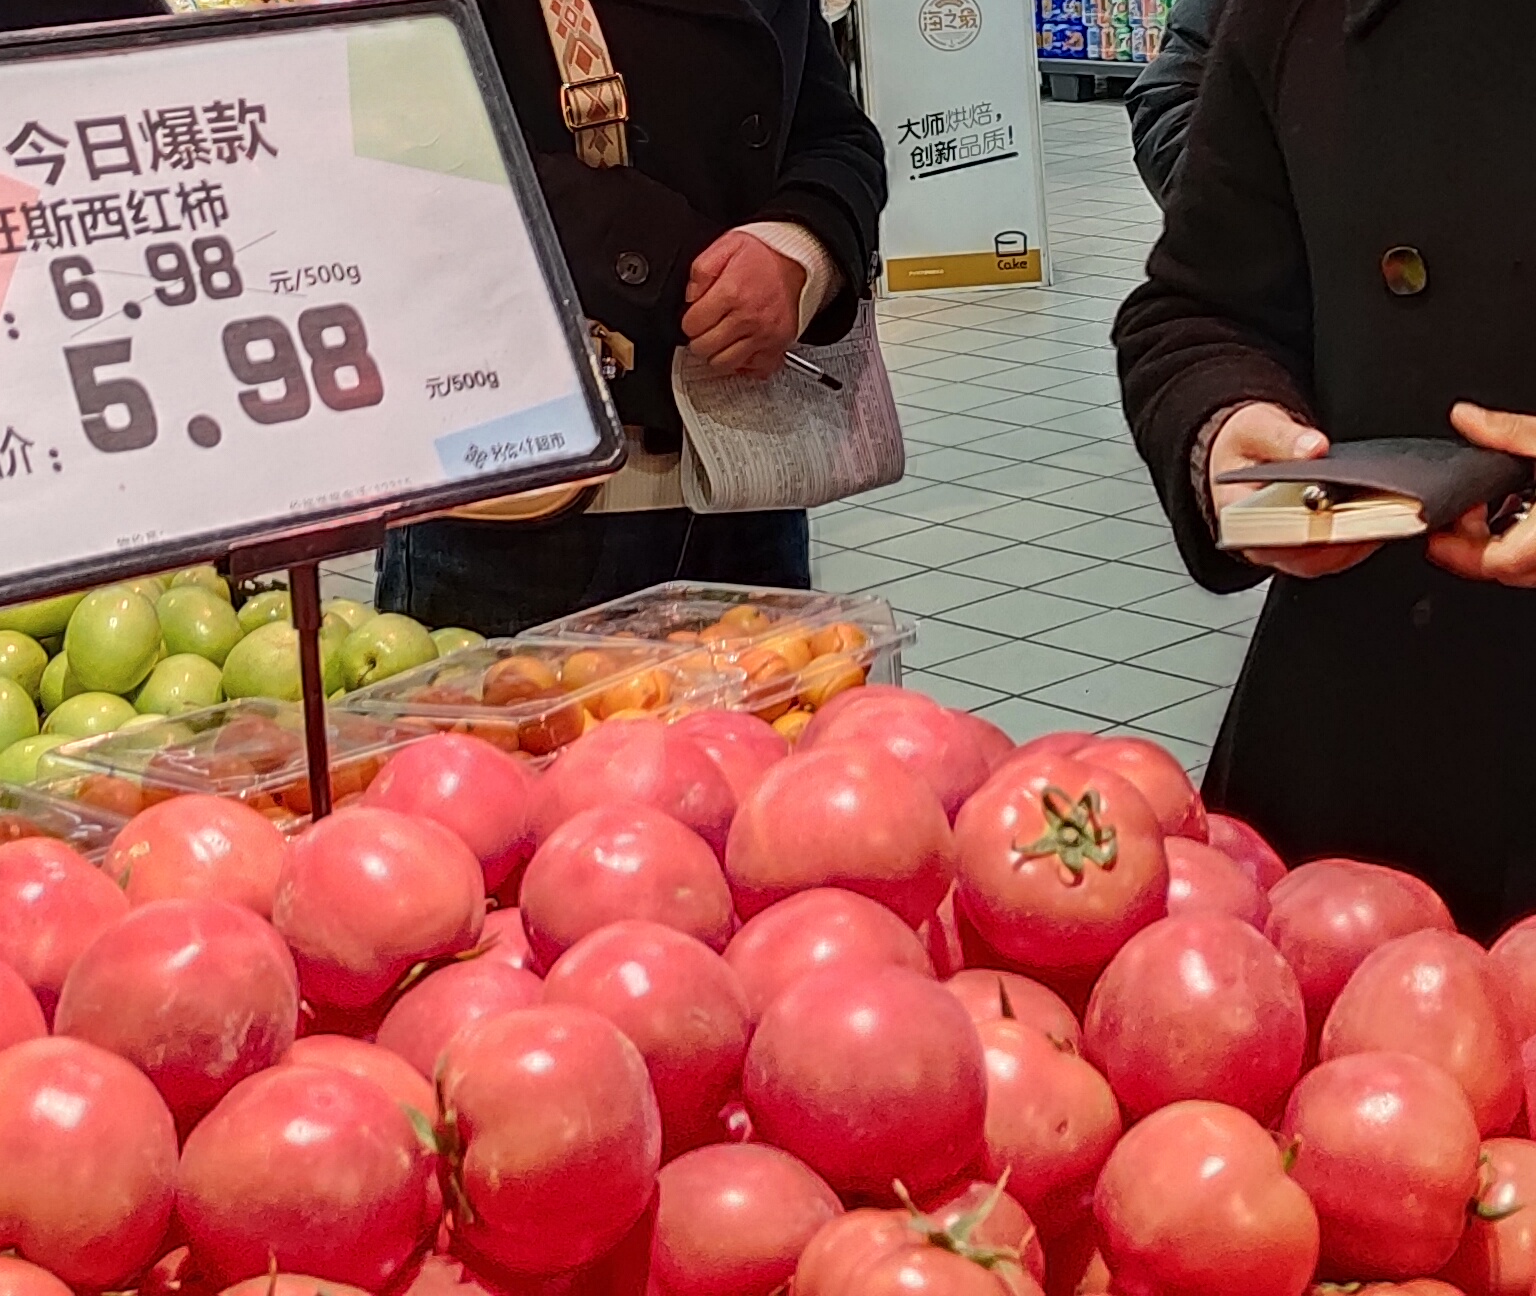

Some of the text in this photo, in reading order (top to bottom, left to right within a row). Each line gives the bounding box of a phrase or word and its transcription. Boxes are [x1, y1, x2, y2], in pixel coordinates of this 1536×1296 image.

[923, 7, 979, 32] 海之最
[4, 97, 279, 186] 今日爆款
[49, 234, 244, 322] 6.98
[269, 261, 362, 295] 元/500g
[996, 258, 1028, 271] Cake
[63, 302, 384, 455] 5.98
[425, 369, 500, 400] 元/500g
